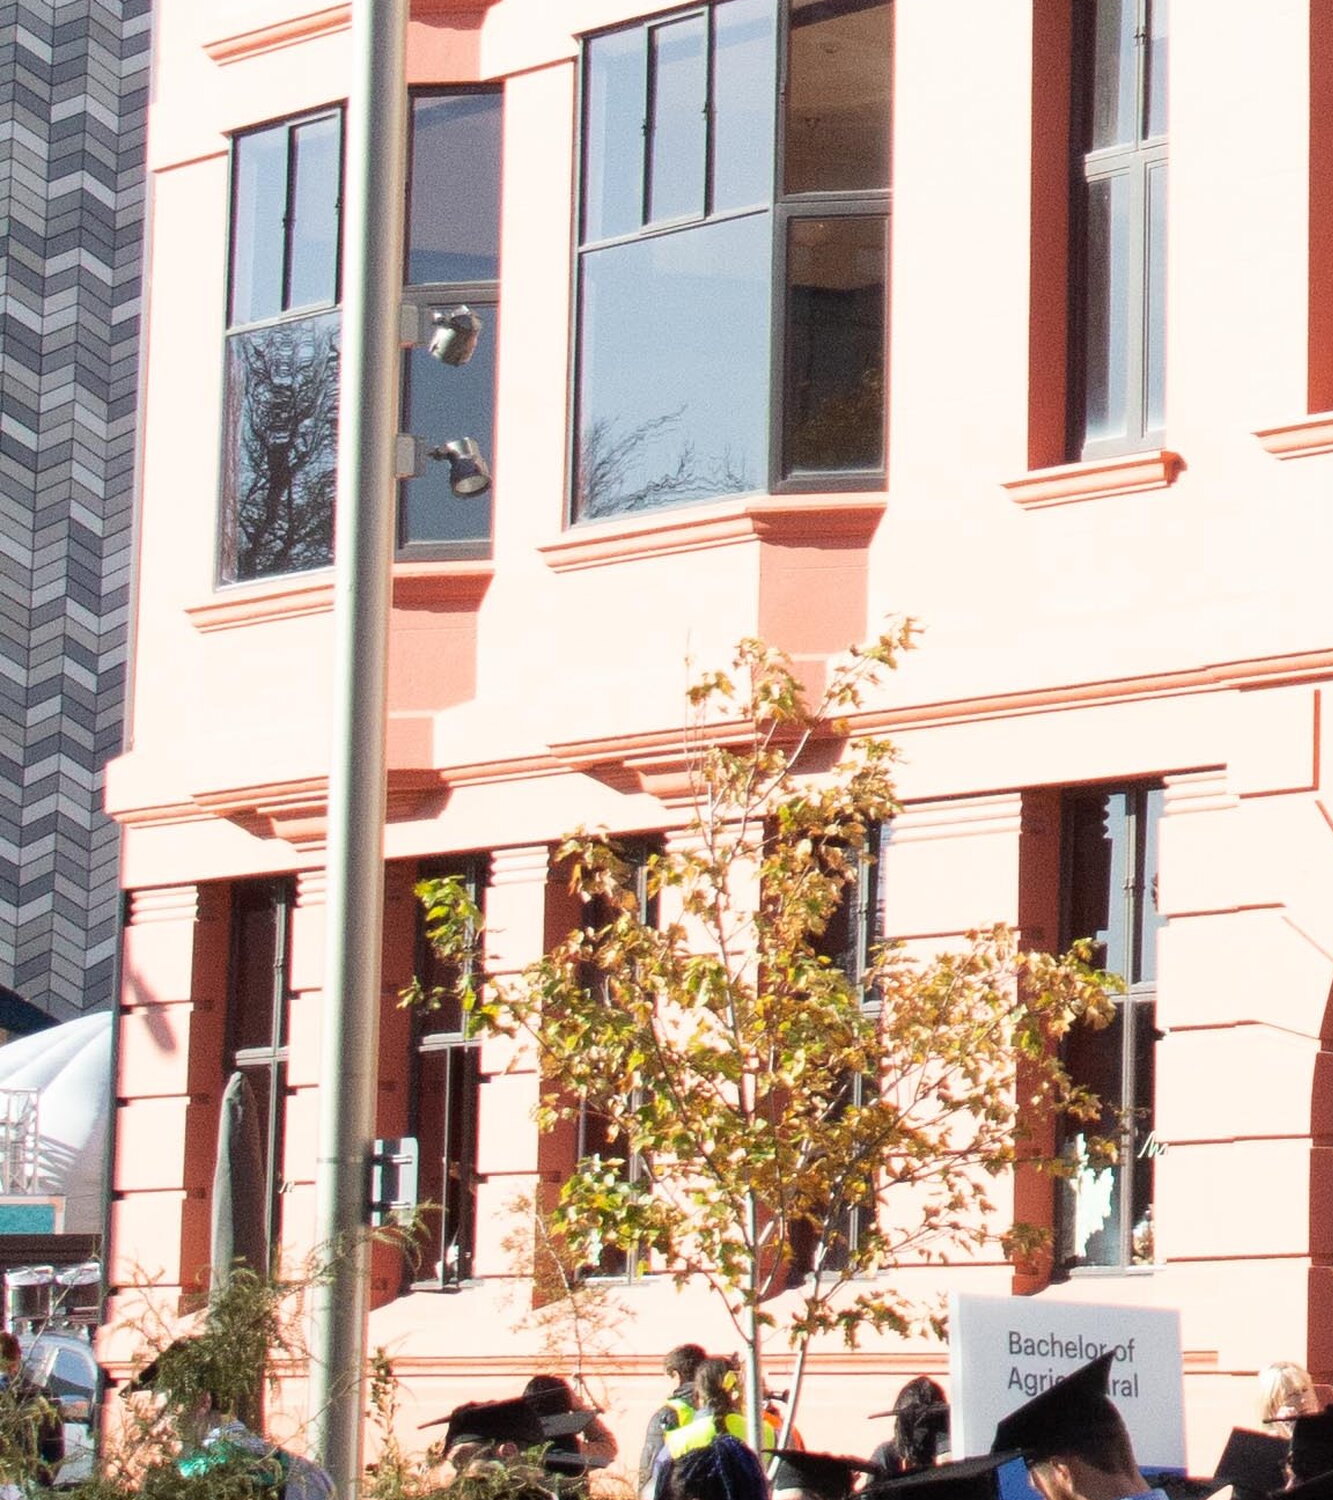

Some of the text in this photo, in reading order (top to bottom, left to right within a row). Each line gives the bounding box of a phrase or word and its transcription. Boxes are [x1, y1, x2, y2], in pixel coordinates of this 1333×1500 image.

[1008, 1329, 1136, 1363] Bachelor of
[1007, 1366, 1139, 1398] Agriral
